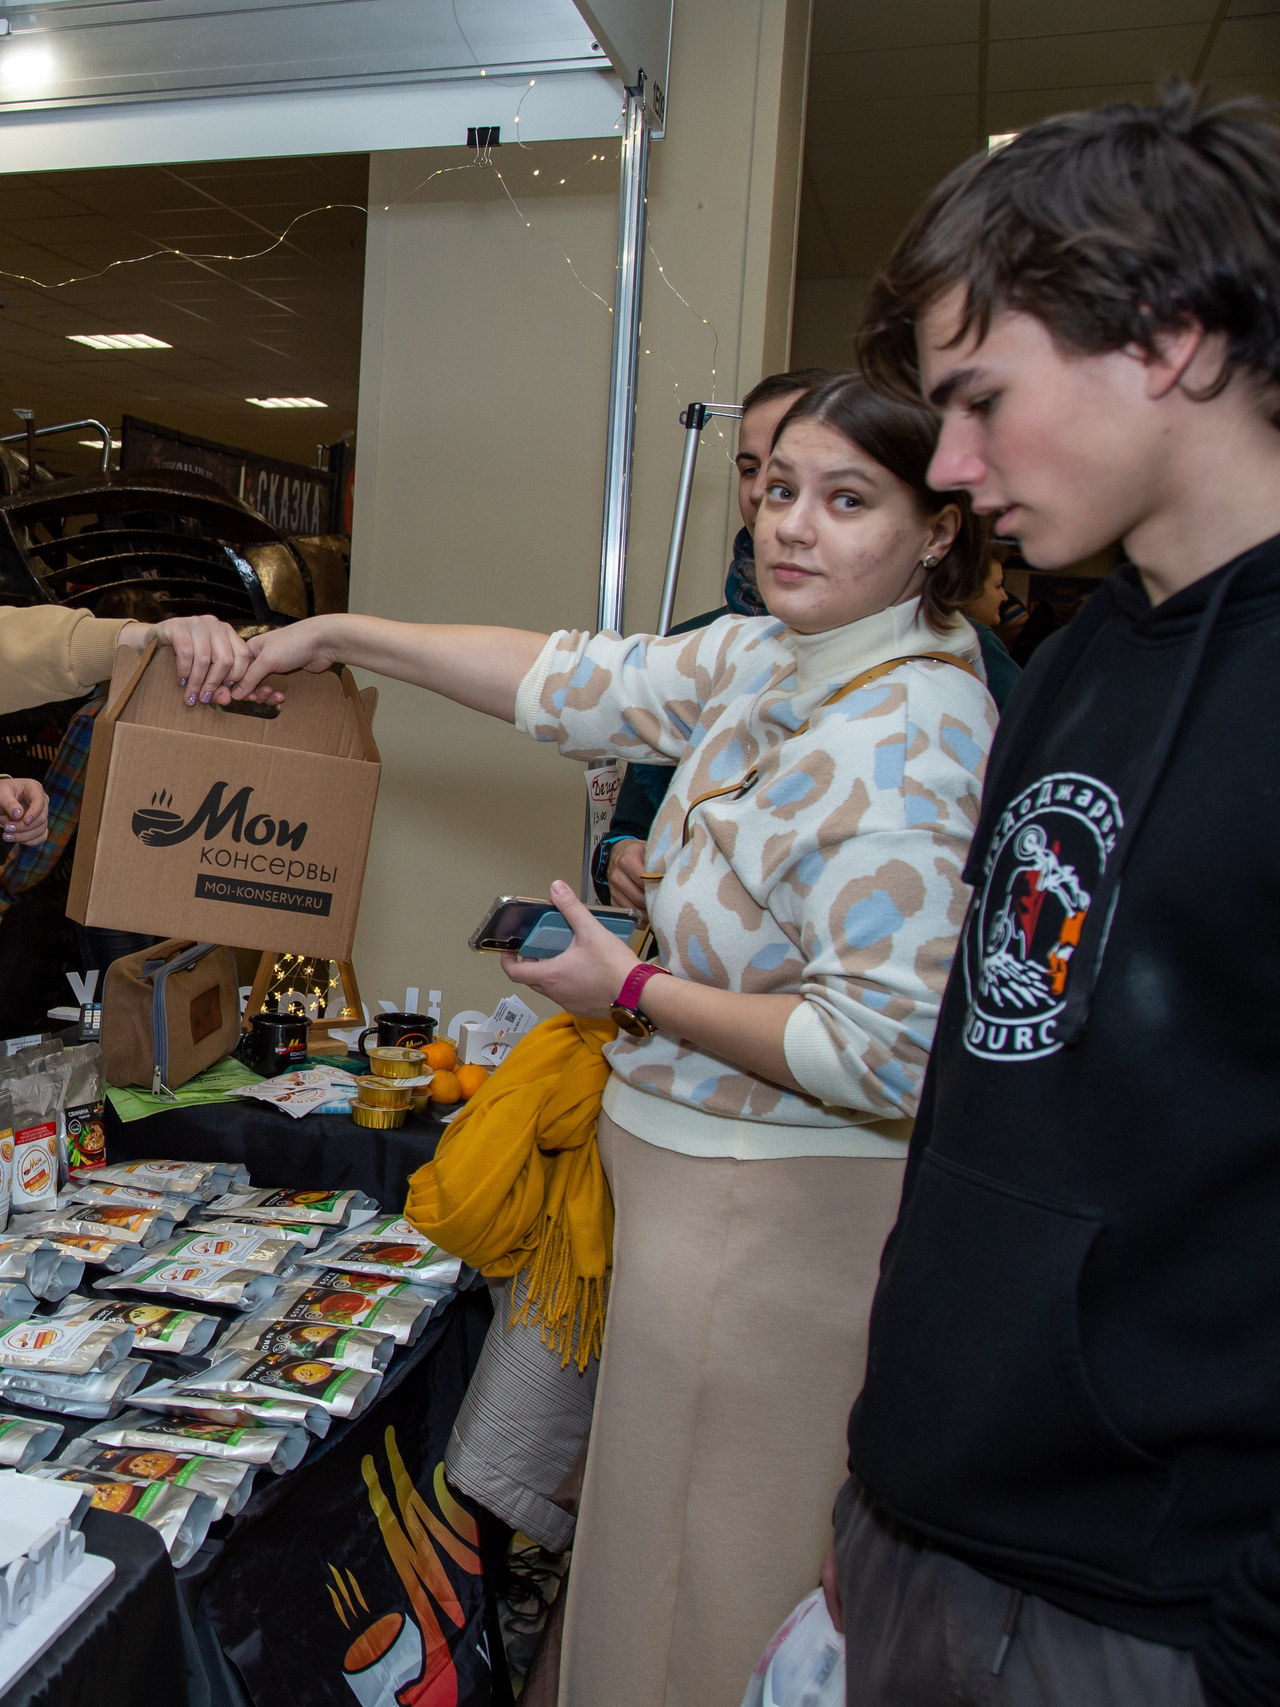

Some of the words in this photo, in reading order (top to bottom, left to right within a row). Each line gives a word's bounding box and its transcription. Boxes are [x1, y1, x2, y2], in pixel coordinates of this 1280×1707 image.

[257, 470, 321, 535] СКАЗКА
[184, 781, 309, 852] Мои
[200, 846, 338, 884] консервы
[204, 881, 324, 910] MOI-KONSERVY.RU
